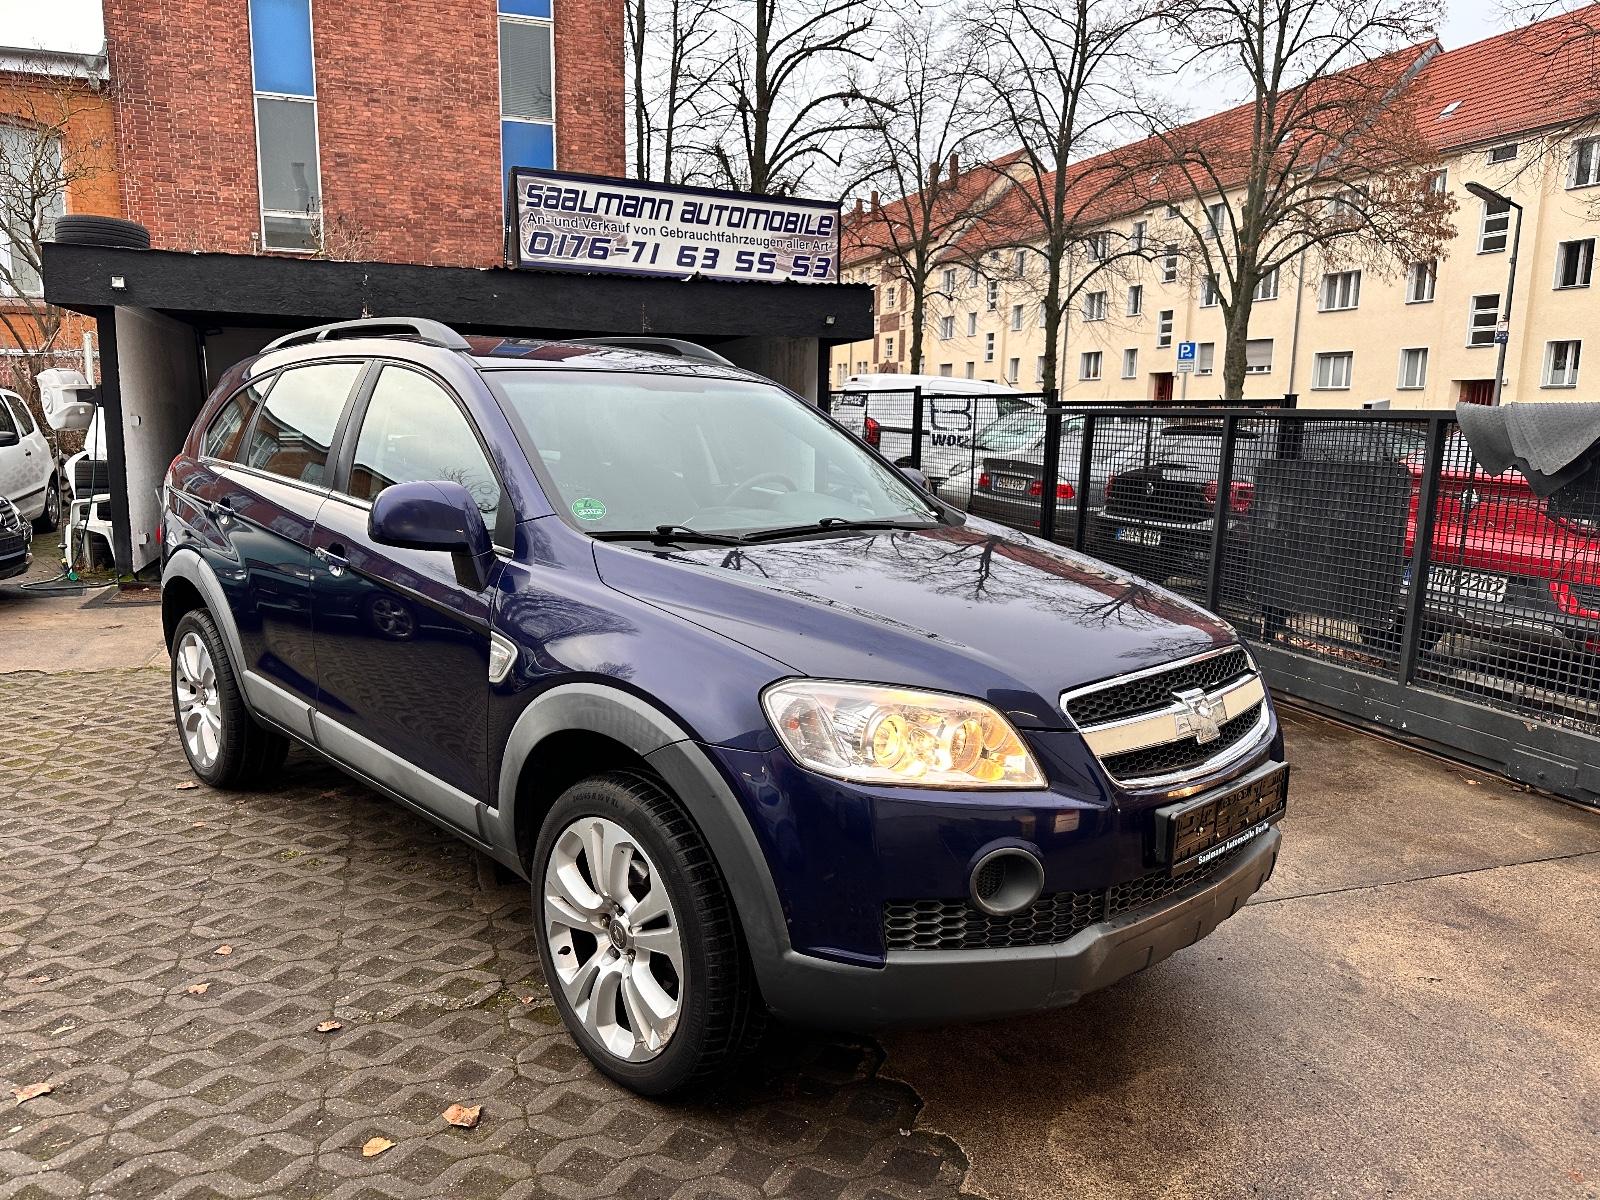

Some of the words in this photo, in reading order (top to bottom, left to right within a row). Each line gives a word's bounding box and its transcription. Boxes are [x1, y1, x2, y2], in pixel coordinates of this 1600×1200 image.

[527, 212, 551, 225] An-
[554, 217, 578, 229] und
[582, 217, 631, 234] Verkauf
[633, 226, 656, 237] von
[659, 225, 785, 249] Gebrauchtfahrzeugen
[786, 238, 810, 250] aller
[676, 245, 720, 269] 63
[734, 250, 777, 274] 55
[791, 255, 832, 278] 53
[1180, 344, 1191, 358] P
